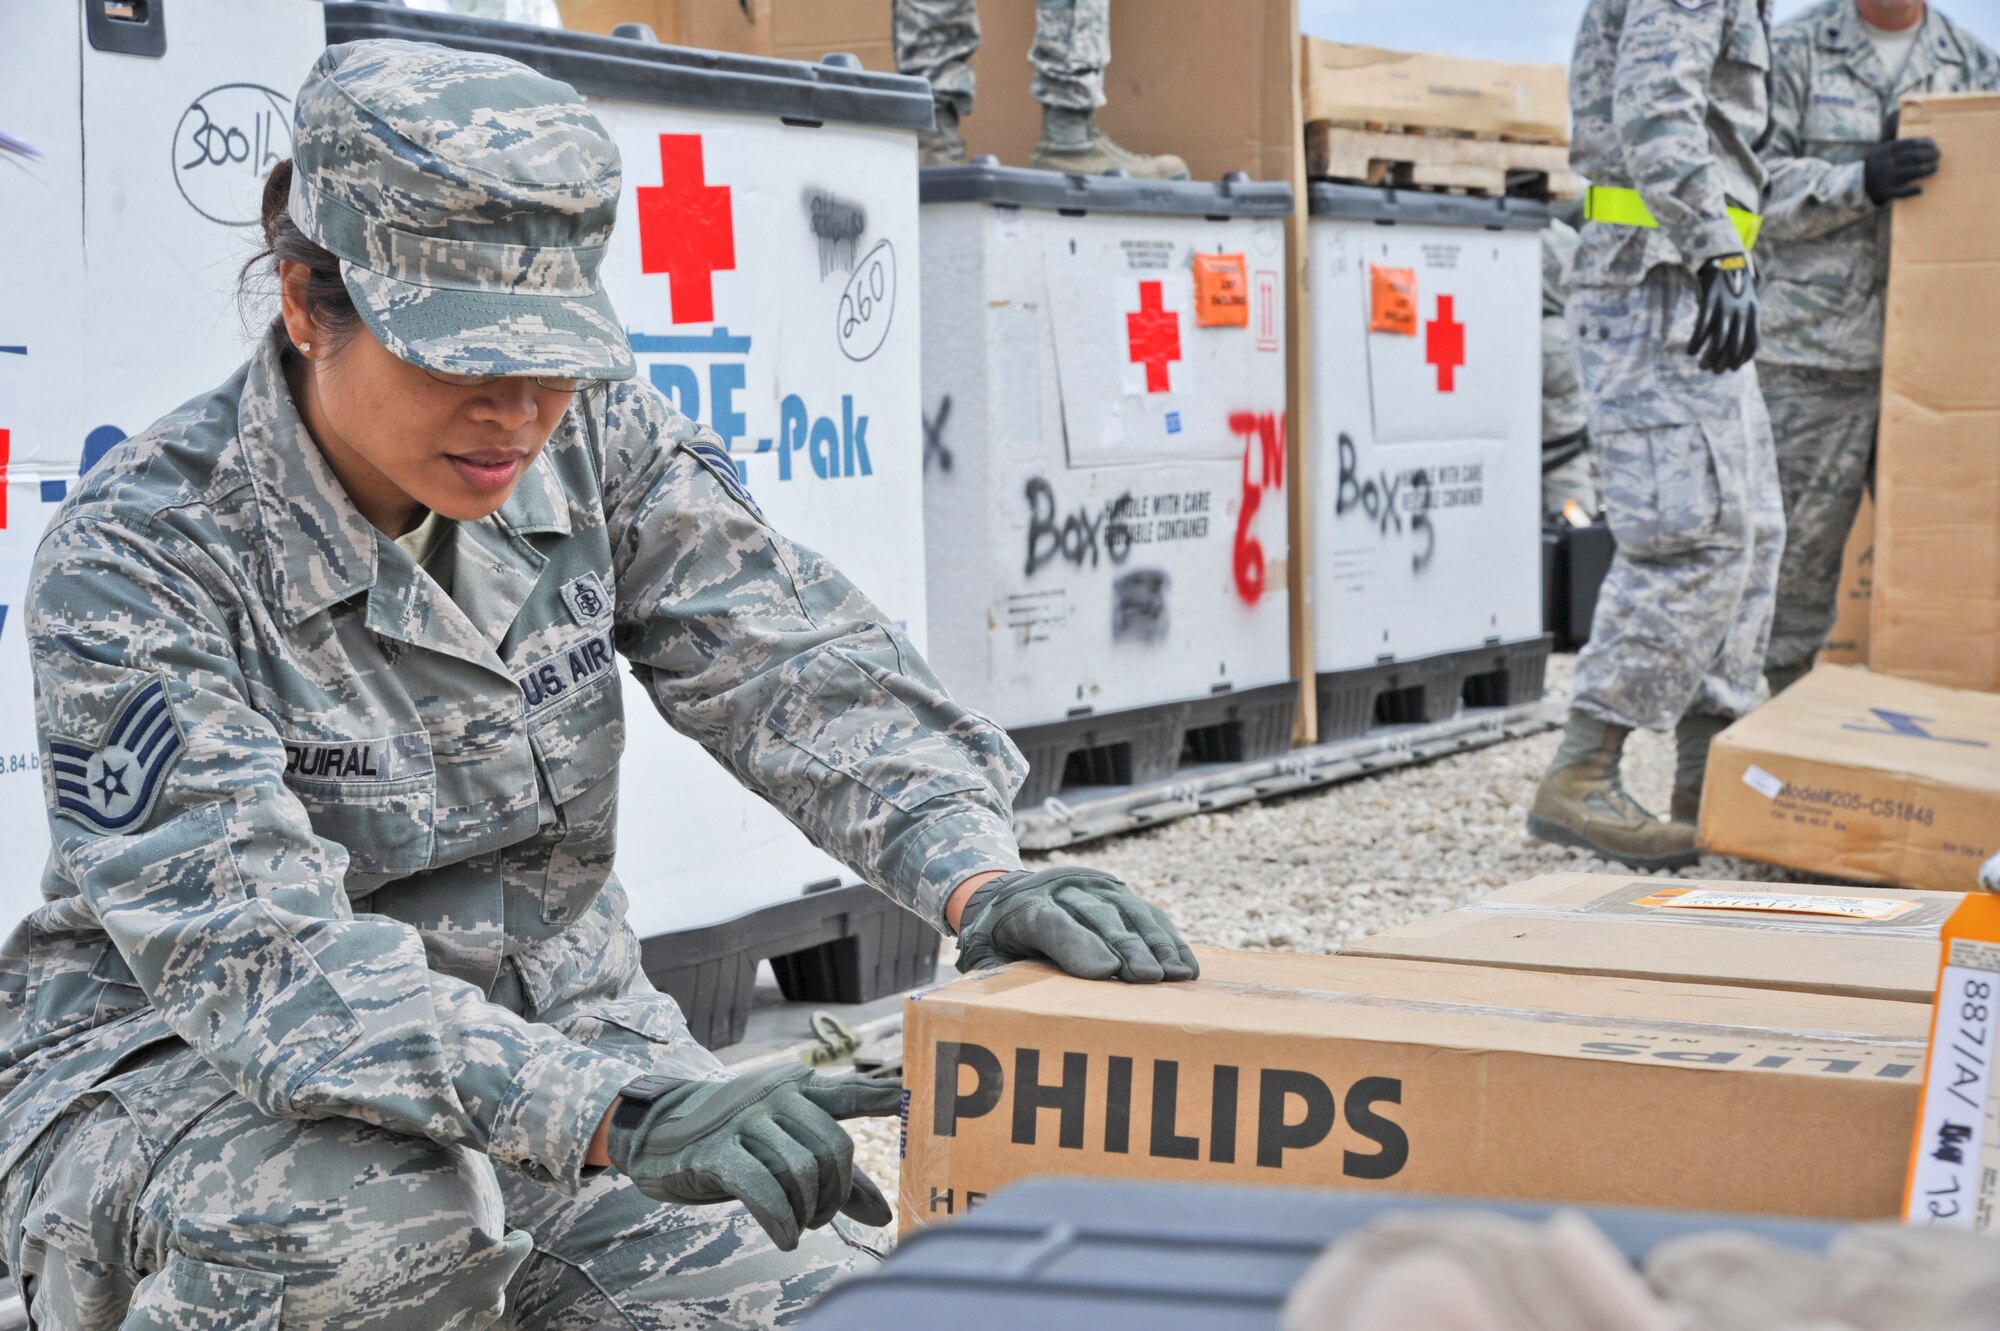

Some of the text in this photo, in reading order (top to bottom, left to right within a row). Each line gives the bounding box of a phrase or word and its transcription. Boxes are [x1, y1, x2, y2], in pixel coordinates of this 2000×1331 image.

[842, 260, 884, 338] 260
[1154, 494, 1179, 515] WITH
[1184, 491, 1210, 512] CARE
[1336, 432, 1402, 537] Box
[1025, 476, 1099, 577] Box
[1157, 516, 1208, 541] CONTAINER
[1233, 484, 1265, 606] 6
[519, 663, 568, 706] U.S.
[568, 636, 610, 683] AIR
[284, 745, 377, 777] QUIRAL
[933, 1040, 1409, 1180] PHILIPS
